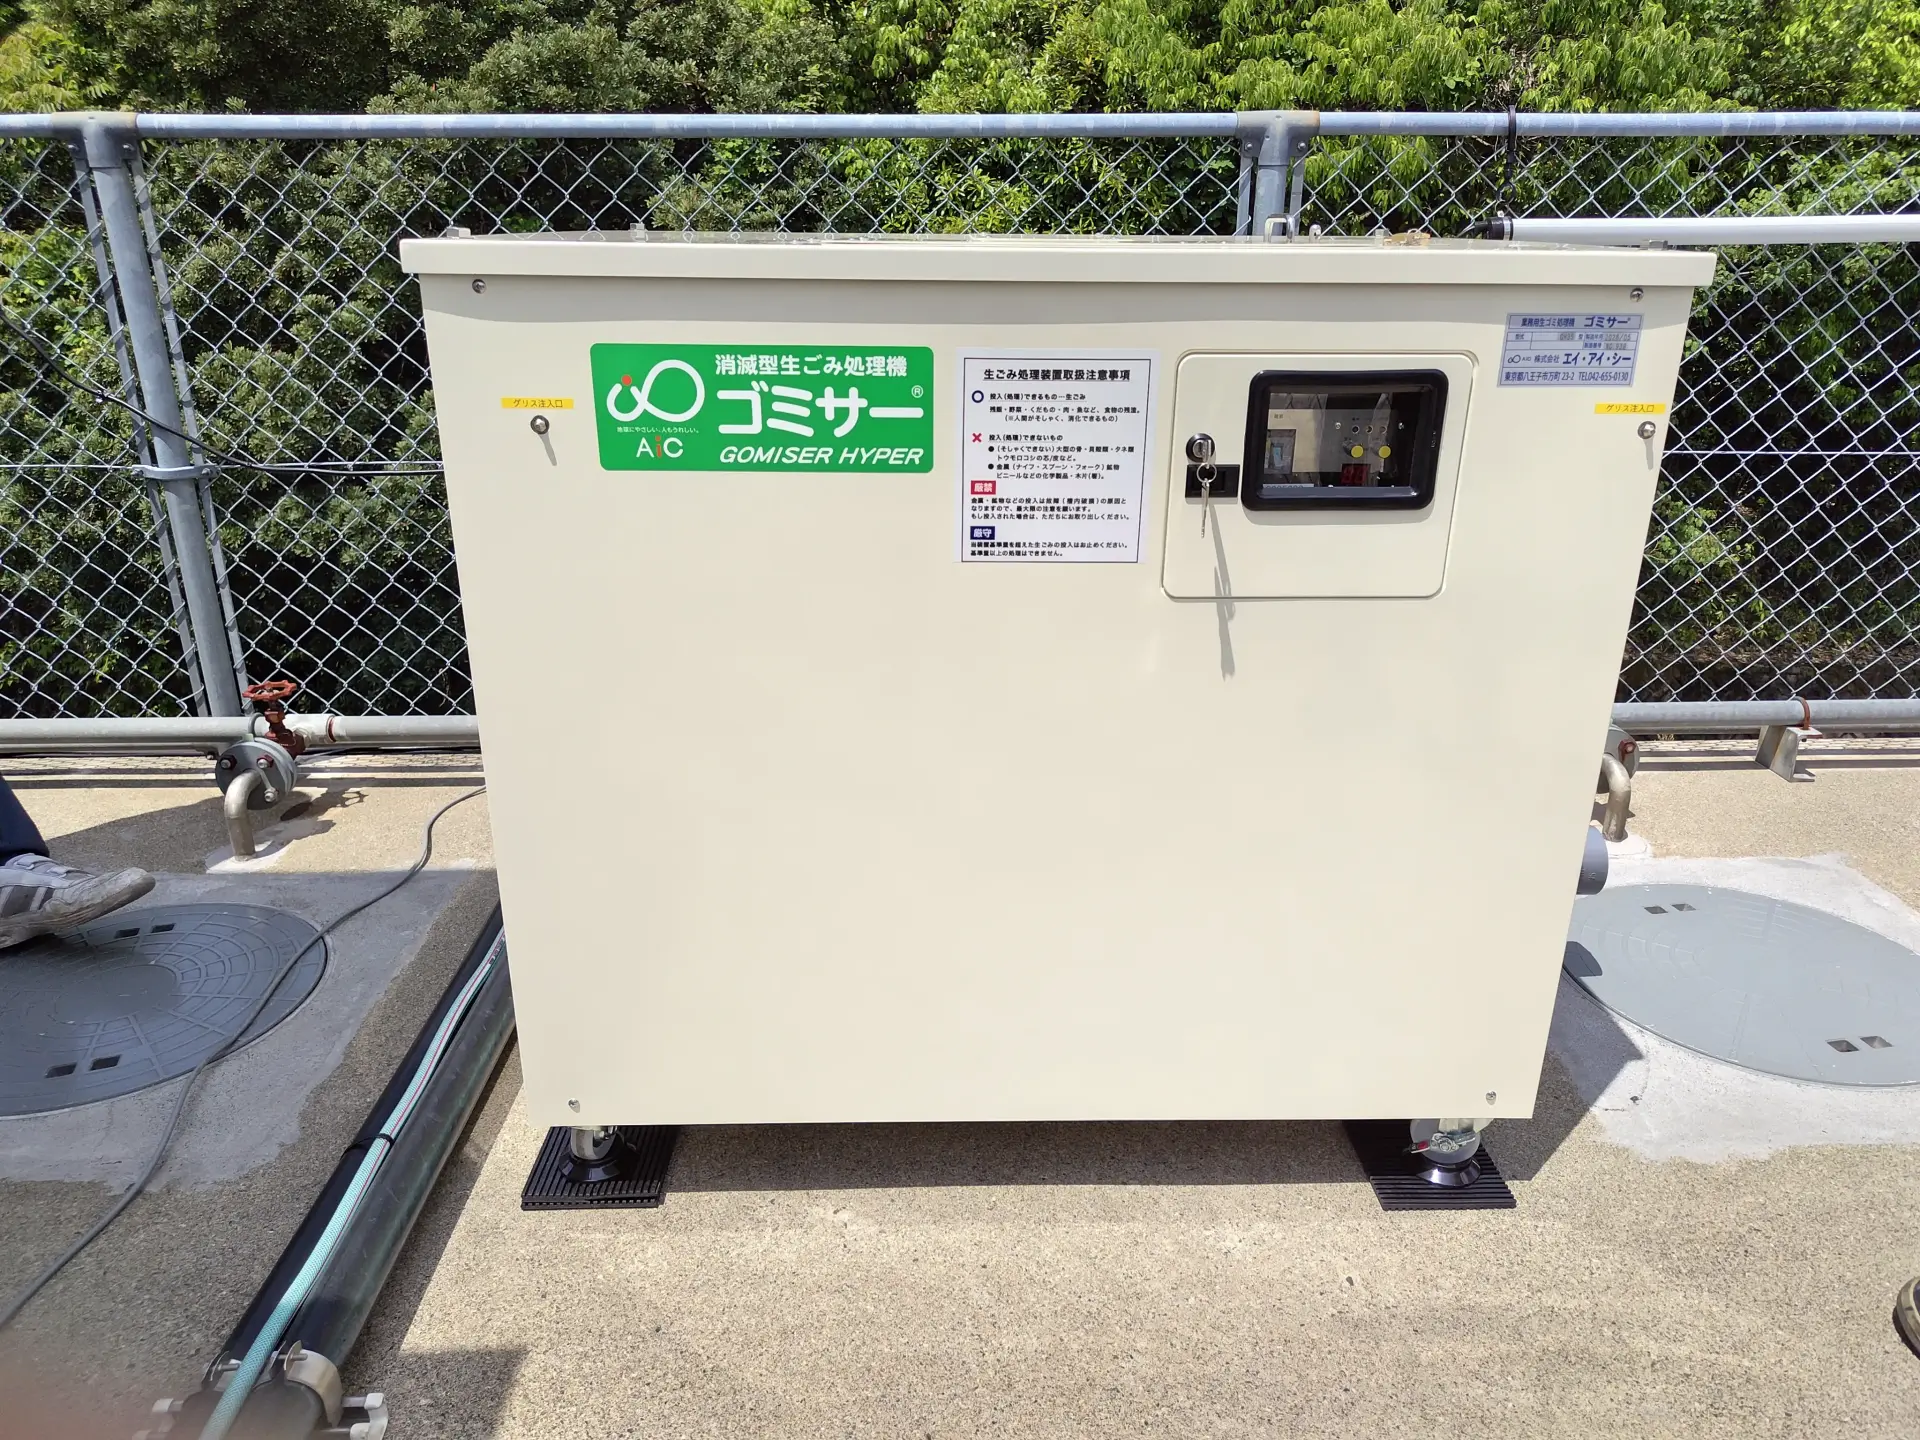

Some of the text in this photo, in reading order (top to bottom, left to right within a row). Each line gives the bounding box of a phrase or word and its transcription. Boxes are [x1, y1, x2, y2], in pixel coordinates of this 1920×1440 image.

[1520, 317, 1576, 328] 業務用生ゴミ処理機
[1534, 354, 1560, 364] 株式会社
[1562, 352, 1632, 366] エイ・アイ・シー
[715, 354, 908, 377] 消滅型生ごみ処理機
[983, 368, 1131, 381] 生ごみ処理装置取扱注意事項
[512, 398, 563, 408] グリス注入口
[1605, 403, 1655, 413] グリス注入口
[719, 446, 925, 466] GOMISER HYPER
[973, 482, 993, 493] 厳禁
[973, 527, 993, 538] 厳守
